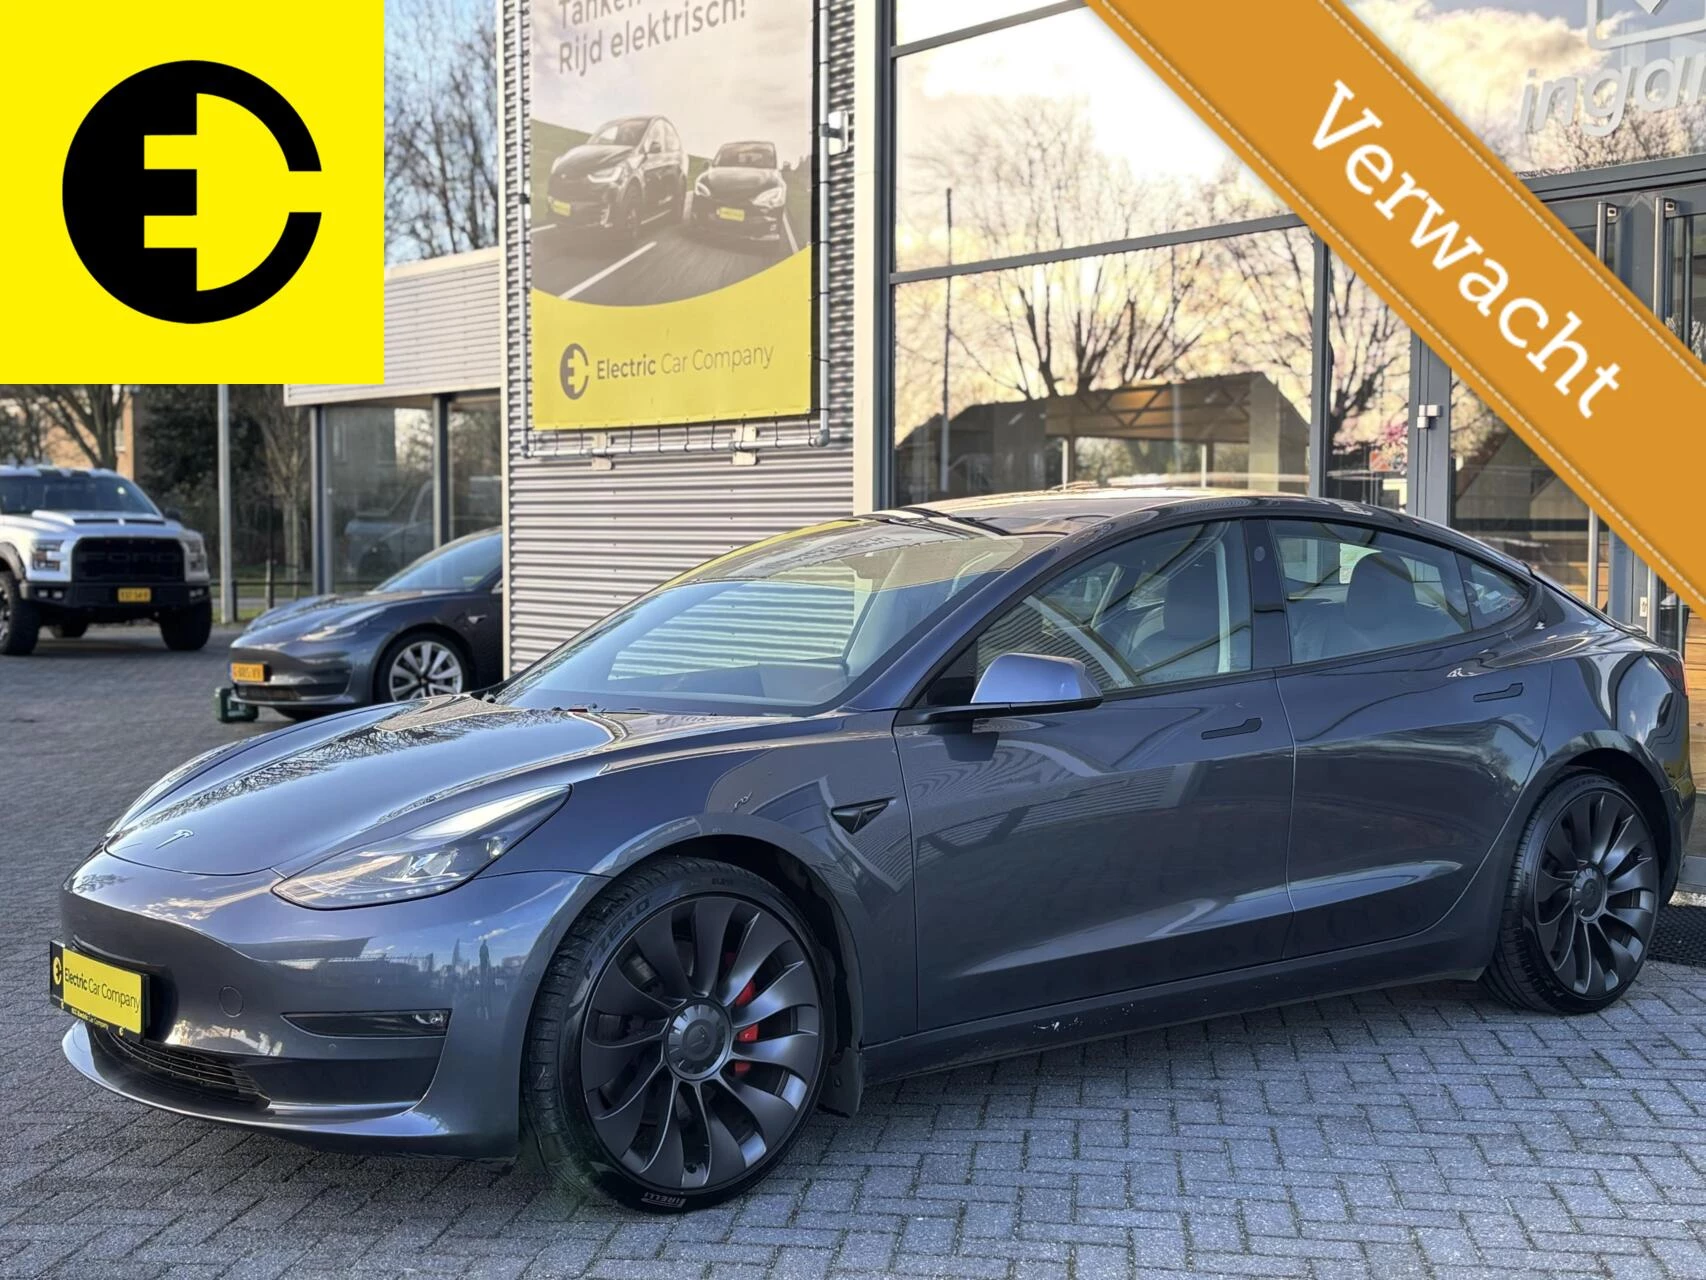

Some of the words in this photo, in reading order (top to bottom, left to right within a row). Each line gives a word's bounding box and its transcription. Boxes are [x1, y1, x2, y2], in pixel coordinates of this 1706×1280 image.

[558, 0, 641, 29] Tank
[559, 30, 602, 77] Rijd
[610, 0, 745, 58] elektrisch!
[1518, 52, 1706, 137] inga
[596, 353, 656, 380] Electric
[660, 352, 688, 375] Car
[692, 345, 774, 374] Company
[64, 967, 88, 993] Electric
[88, 978, 100, 996] Car
[101, 983, 140, 1014] Company
